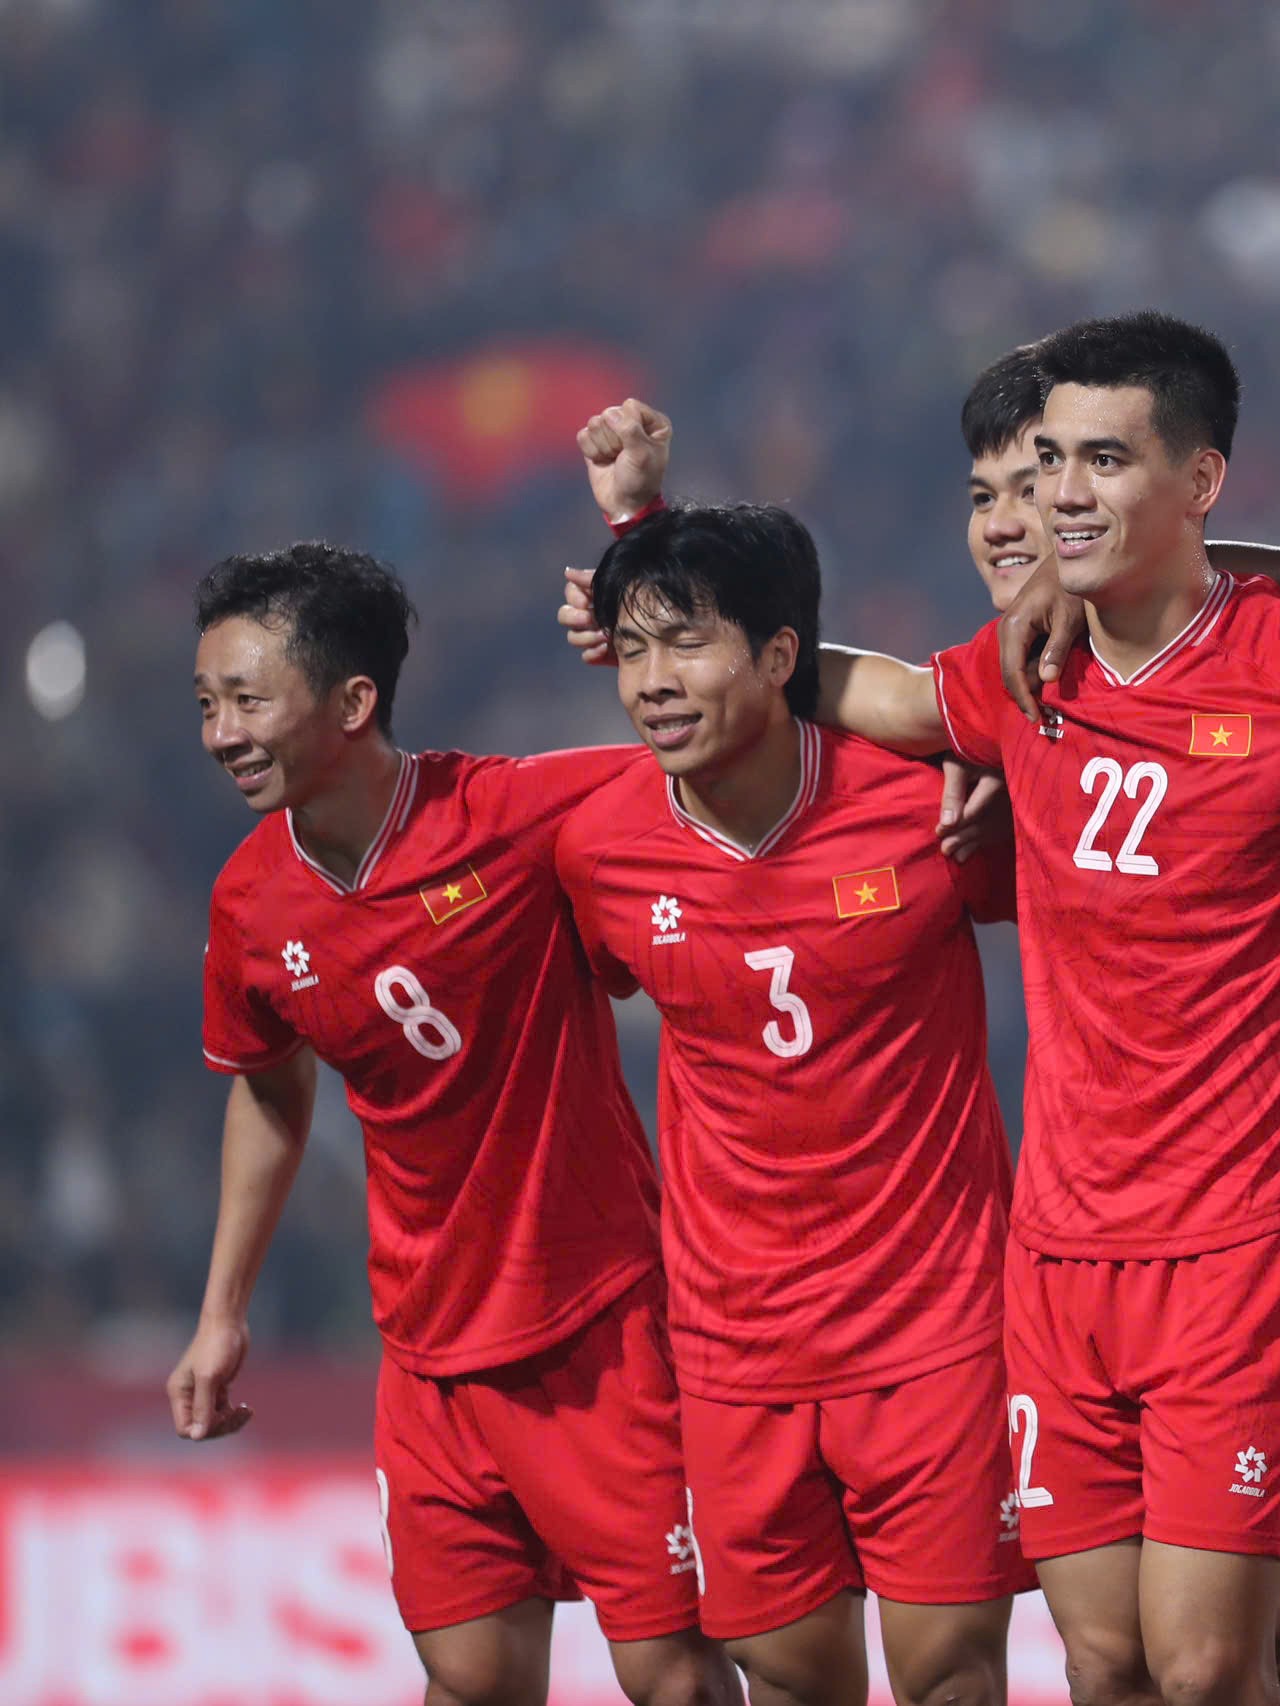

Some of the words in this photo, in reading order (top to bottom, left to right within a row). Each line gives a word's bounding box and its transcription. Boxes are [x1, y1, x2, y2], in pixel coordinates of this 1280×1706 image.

[1073, 756, 1168, 876] 22
[374, 965, 462, 1061] 8
[744, 945, 813, 1058] 3
[1006, 1393, 1054, 1509] 2
